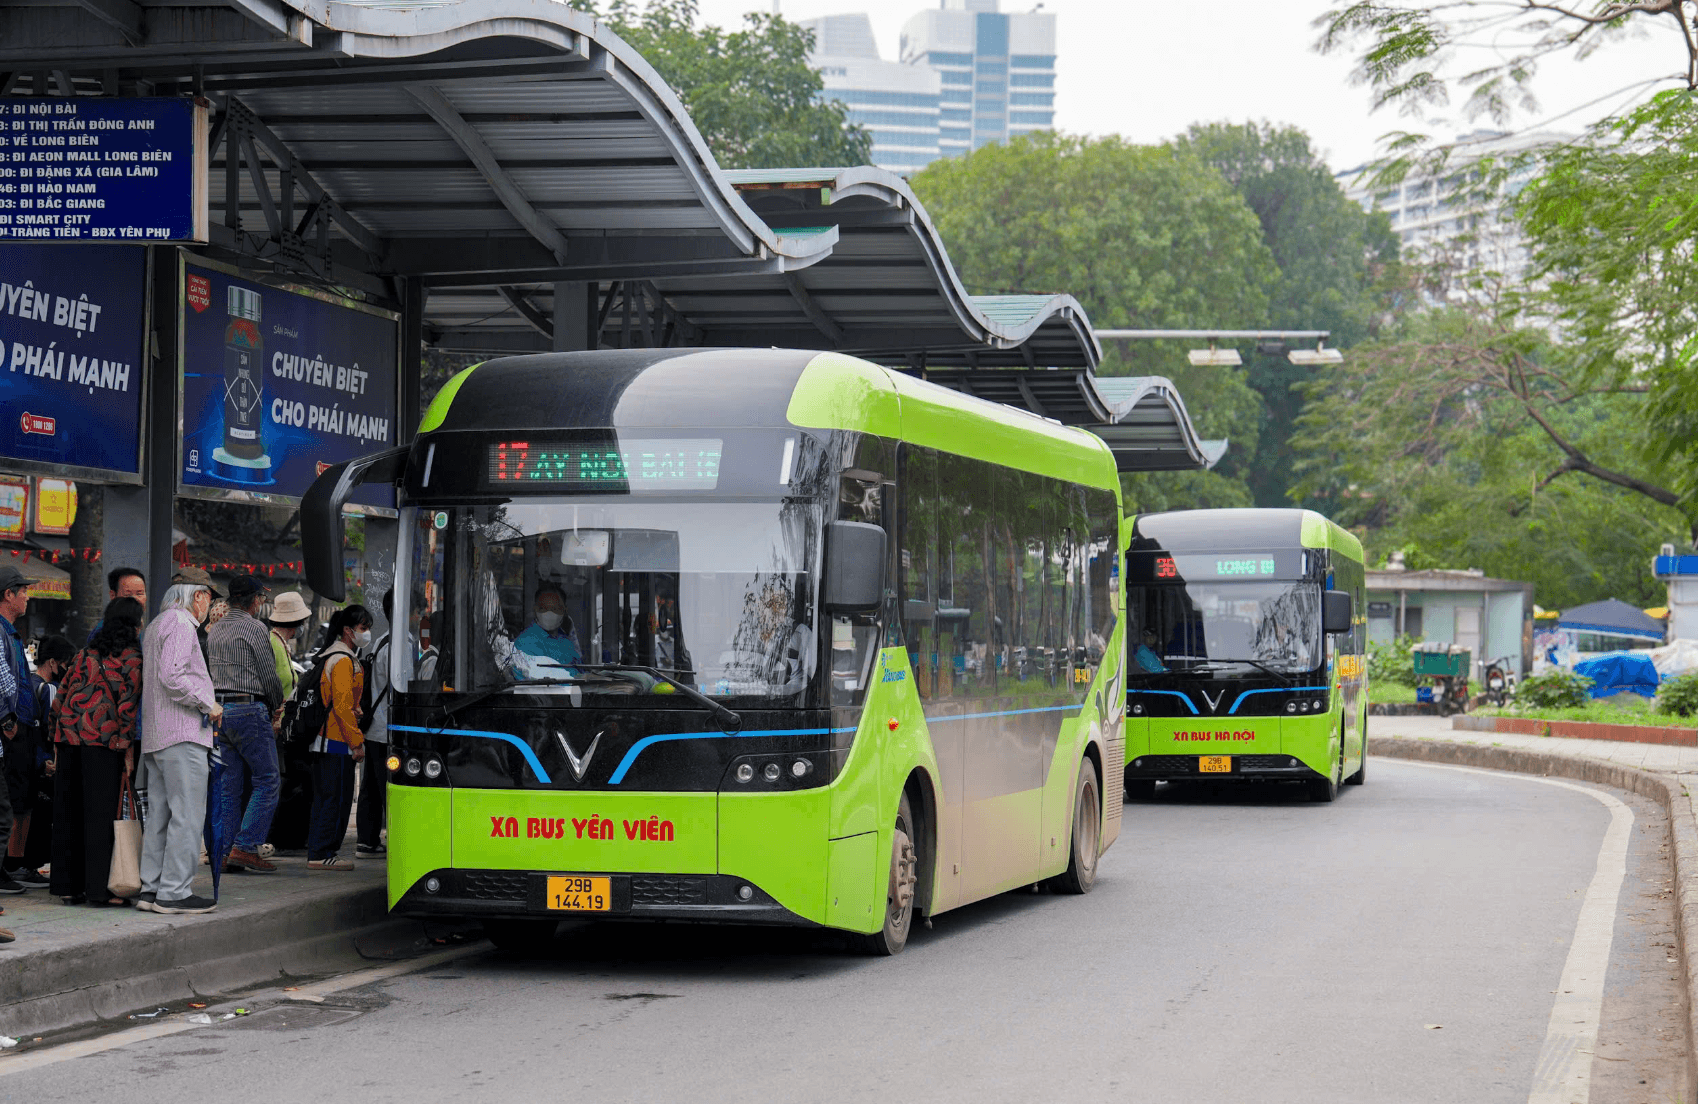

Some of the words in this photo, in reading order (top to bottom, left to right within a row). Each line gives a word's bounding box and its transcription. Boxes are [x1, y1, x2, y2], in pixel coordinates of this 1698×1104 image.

[13, 105, 26, 114] ĐI
[30, 103, 51, 116] NỘI
[56, 102, 76, 114] BÀI
[12, 121, 25, 130] ĐI
[29, 121, 48, 132] THỊ
[52, 117, 85, 130] TRẤN
[89, 118, 124, 130] ĐÔNG
[128, 120, 155, 130] ANH
[32, 137, 65, 146] LONG
[69, 133, 99, 145] BIÊN
[12, 152, 25, 161] ĐI
[29, 152, 63, 161] AEON
[67, 152, 101, 161] MALL
[105, 151, 138, 161] LONG
[142, 149, 172, 161] BIÊN
[20, 168, 33, 177] ĐI
[36, 165, 72, 179] ĐẶNG
[75, 165, 93, 177] XÁ
[96, 167, 123, 178] (GIA
[126, 165, 159, 178] LÂM)
[20, 184, 33, 193] ĐI
[37, 180, 63, 193] HÀO
[66, 184, 96, 193] NAM
[20, 199, 33, 208] ĐI
[37, 195, 62, 209] BẮC
[66, 199, 105, 209] GIANG
[16, 215, 60, 224] SMART
[64, 215, 91, 224] CITY
[11, 225, 50, 237] TRÀNG
[92, 228, 116, 237] BĐX
[120, 225, 142, 237] YÊN
[146, 228, 170, 239] PHỤ
[53, 293, 102, 339] BIỆT
[9, 341, 65, 381] PHÁI
[67, 353, 130, 395] MẠNH
[272, 351, 334, 388] CHUYÊN
[336, 362, 369, 400] BIỆT
[271, 398, 305, 428] CHO
[308, 402, 345, 435] PHÁI
[346, 412, 389, 445] MẠNH
[498, 442, 529, 479] 17
[1217, 560, 1256, 574] LONG
[1191, 731, 1211, 741] BUS
[1232, 728, 1255, 744] NỘI
[1203, 764, 1228, 772] 140.51
[1208, 757, 1222, 765] 29B
[527, 817, 565, 839] BUS
[572, 814, 614, 840] YÊN
[622, 815, 674, 841] VIÊN
[564, 878, 593, 893] 29B
[555, 894, 604, 910] 144.19
